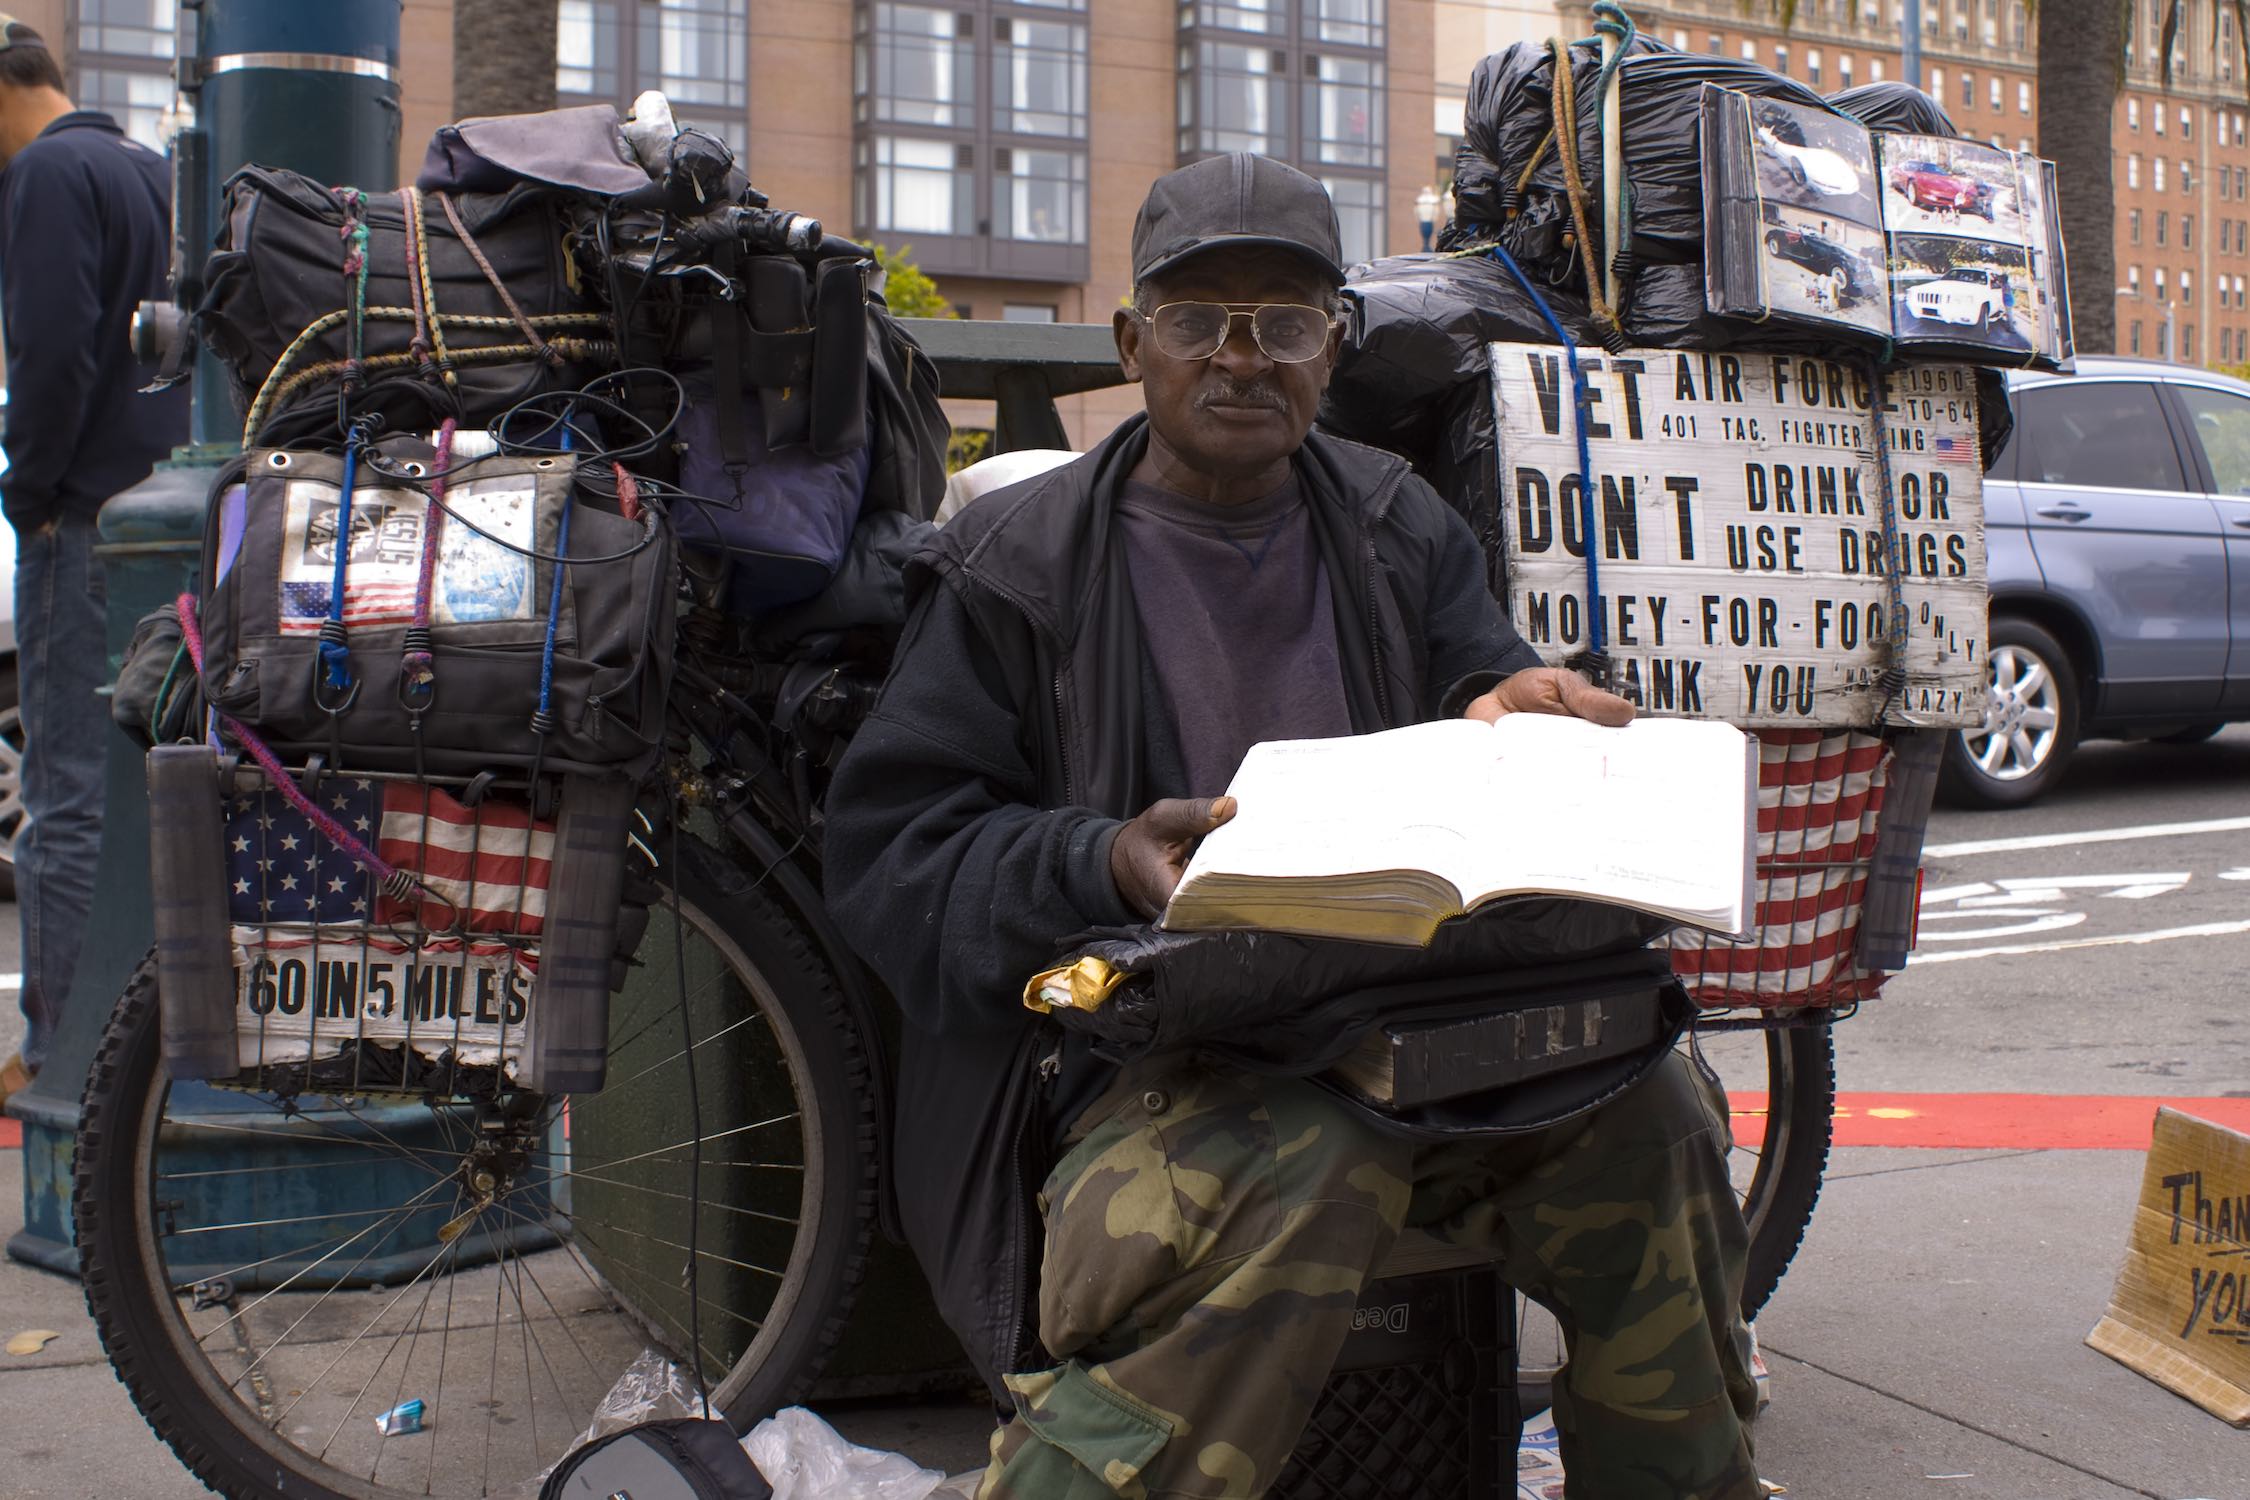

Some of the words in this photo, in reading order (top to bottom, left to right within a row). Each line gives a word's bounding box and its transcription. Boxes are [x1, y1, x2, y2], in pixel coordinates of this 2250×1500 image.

[1527, 353, 1646, 440] VET
[1675, 353, 1744, 403] AIR
[1772, 356, 1899, 413] FORCE
[1909, 369, 1964, 392] 1960
[1661, 414, 1698, 439] 401
[1721, 417, 1767, 443] TAC.
[1781, 419, 1863, 449] FIGHTER
[378, 506, 420, 566] JESUS
[1515, 467, 1700, 561] DON'T
[1745, 462, 1865, 516] DRINK
[1901, 471, 1950, 521] OR
[1726, 525, 1804, 573] USE
[1920, 600, 1976, 662] ONLY
[1744, 663, 1816, 716] YOU
[317, 960, 359, 1019] IN
[367, 963, 395, 1019] 5
[402, 964, 529, 1025] MILES
